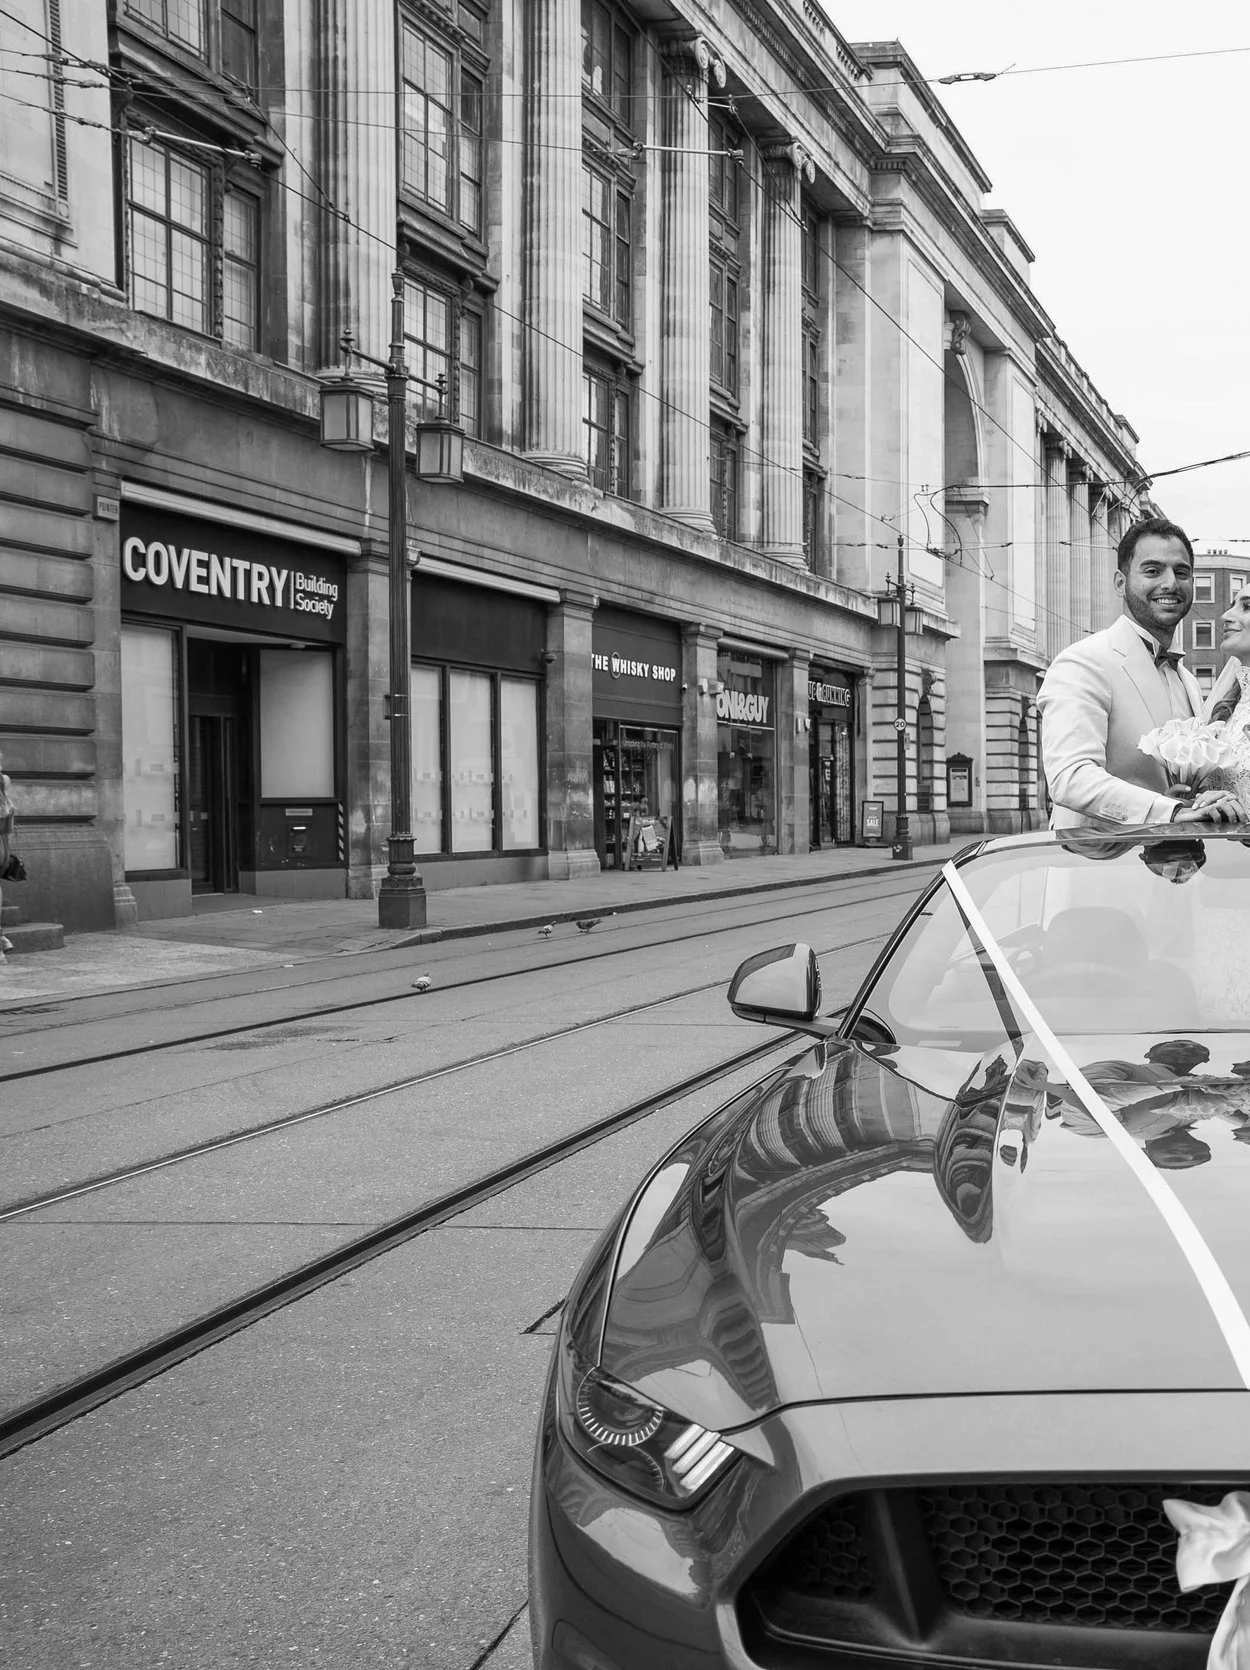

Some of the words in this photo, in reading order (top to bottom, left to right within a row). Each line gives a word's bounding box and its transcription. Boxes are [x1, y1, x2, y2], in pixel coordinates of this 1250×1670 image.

[123, 536, 289, 608] COVENTRY
[296, 572, 339, 601] Building
[296, 594, 334, 620] Society
[591, 653, 609, 671] THE
[612, 657, 650, 678] WHISKY
[652, 664, 676, 682] SHOP
[716, 689, 770, 724] ONI&GUY
[895, 720, 905, 728] 20
[866, 818, 880, 827] SALE
